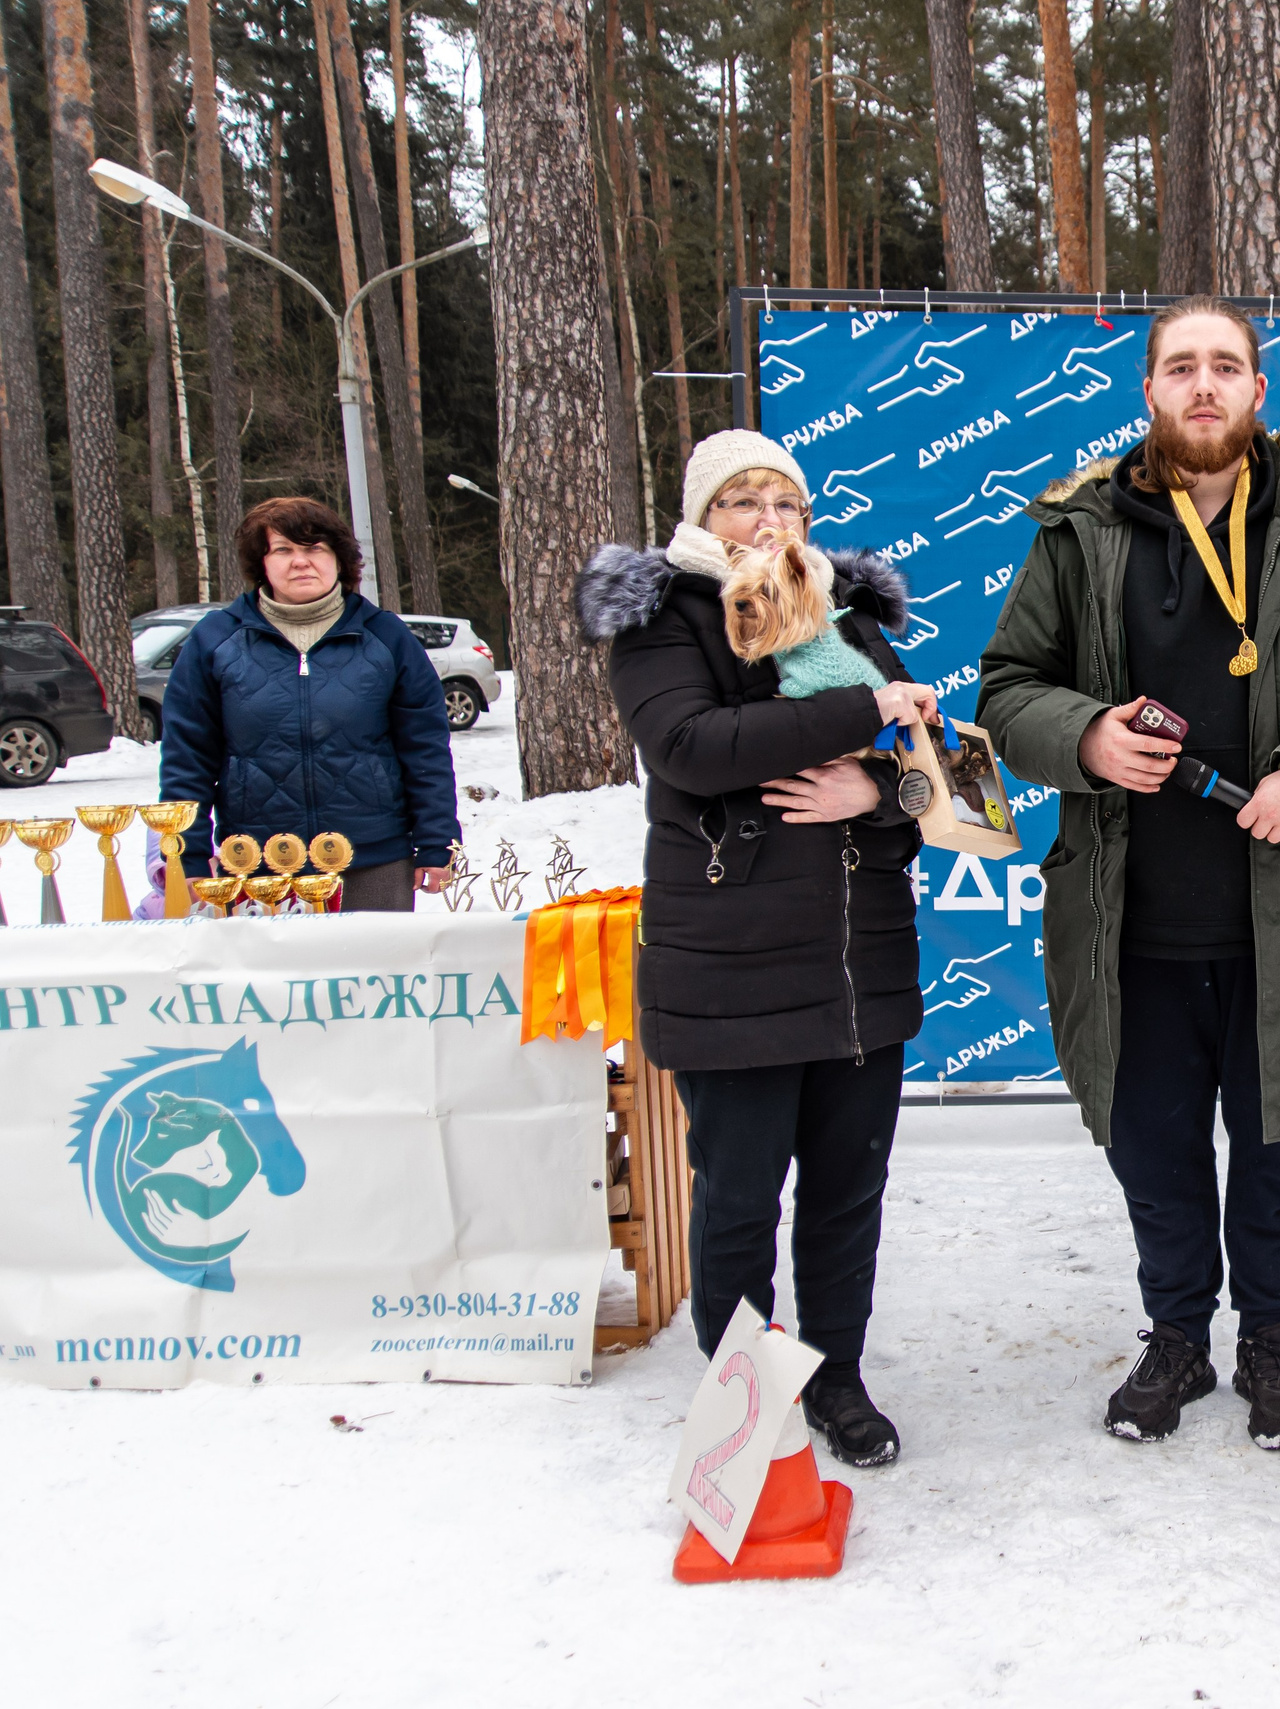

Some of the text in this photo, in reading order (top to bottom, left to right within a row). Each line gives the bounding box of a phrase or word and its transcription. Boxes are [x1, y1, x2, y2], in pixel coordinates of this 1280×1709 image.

[782, 403, 863, 452] РУЖБА
[918, 409, 1011, 468] ДРУЖБА
[1076, 413, 1154, 469] ДРУЖБ
[876, 531, 930, 564] ЖБА
[935, 664, 979, 699] УЖБ
[1008, 785, 1060, 817] ЖБА
[946, 1019, 1035, 1075] ДРУЖБА
[372, 1291, 580, 1318] 8-930-804-31-88
[56, 1333, 301, 1362] mcnnov.com
[370, 1333, 575, 1356] zoocenternn@mail.ru
[687, 1351, 760, 1532] 2
